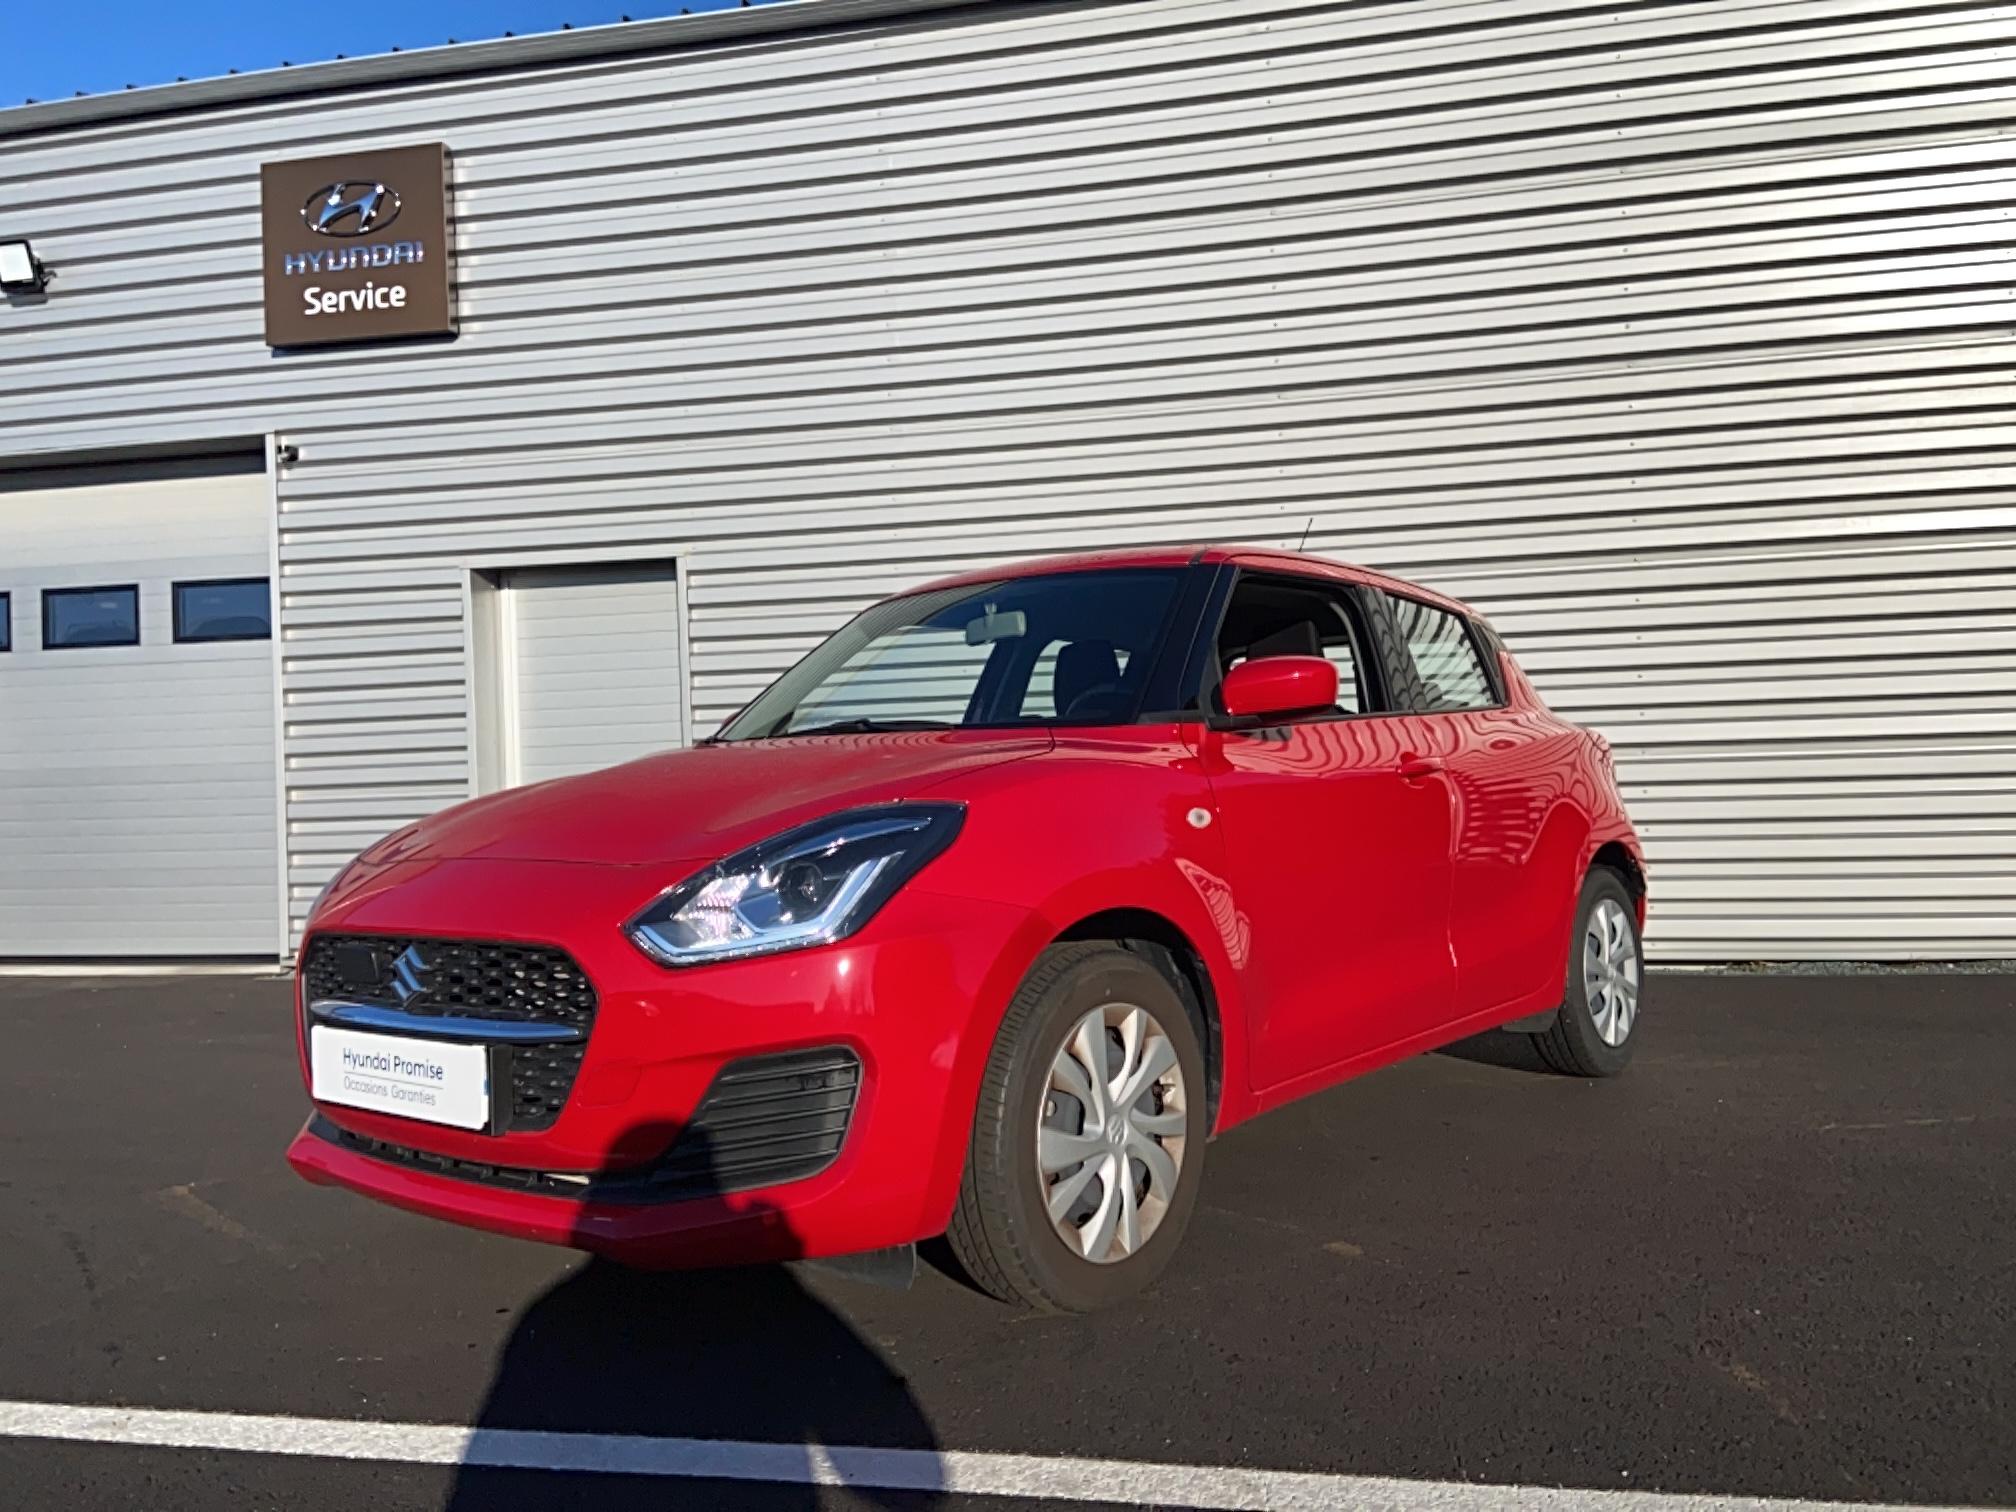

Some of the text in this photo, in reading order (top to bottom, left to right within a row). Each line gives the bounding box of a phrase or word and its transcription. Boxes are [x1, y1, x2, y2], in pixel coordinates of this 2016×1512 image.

[284, 241, 423, 275] HYUNDAI
[304, 281, 406, 315] Service
[343, 1047, 443, 1080] Hyundai Promise
[344, 1075, 436, 1106] Occasions Garanties
